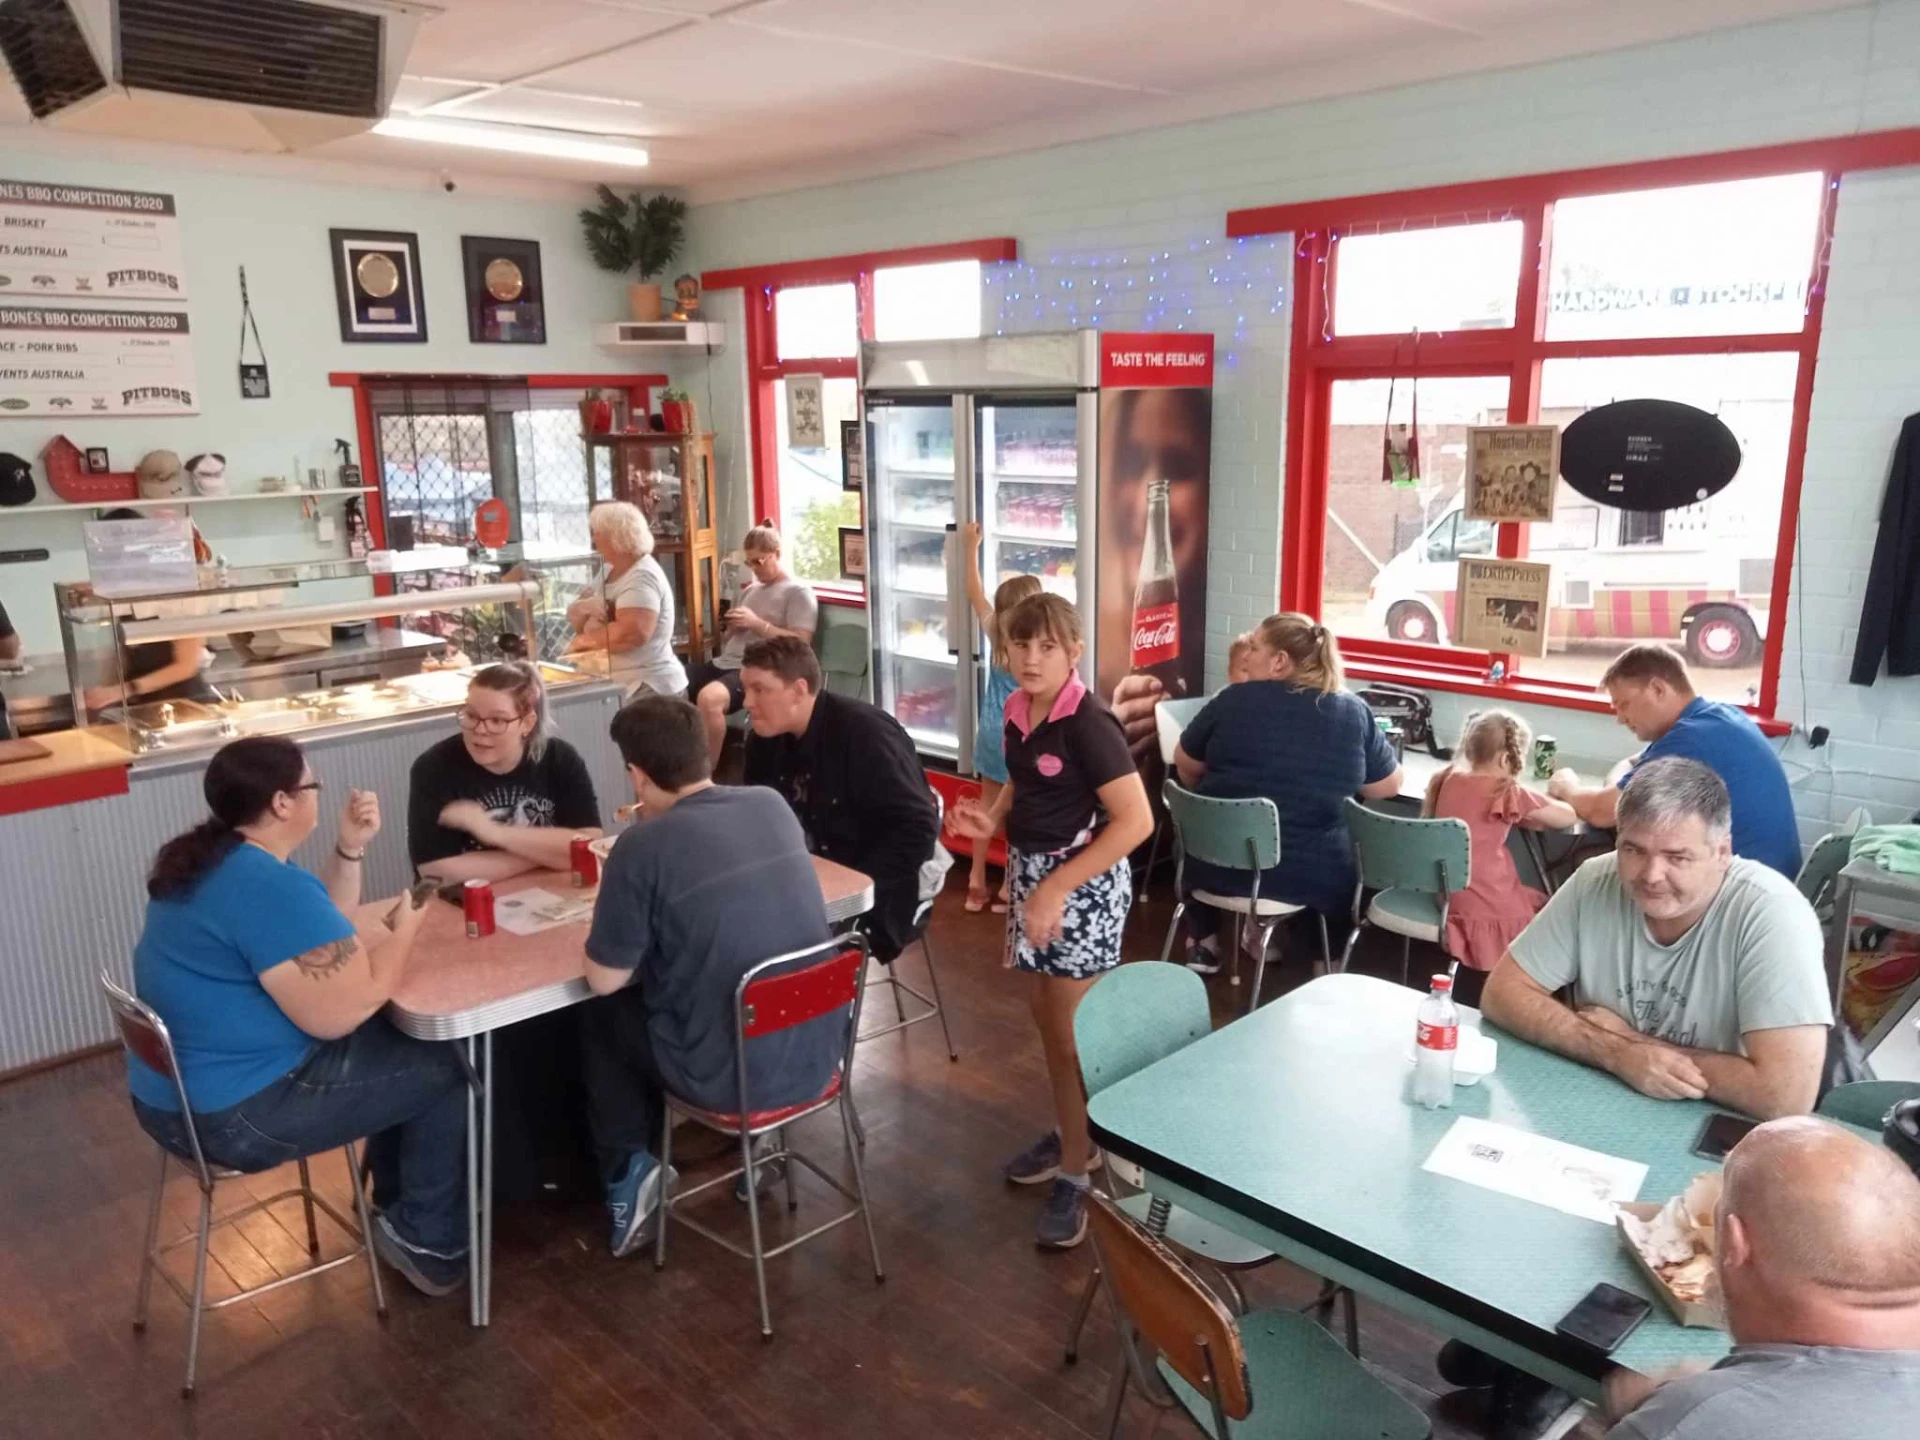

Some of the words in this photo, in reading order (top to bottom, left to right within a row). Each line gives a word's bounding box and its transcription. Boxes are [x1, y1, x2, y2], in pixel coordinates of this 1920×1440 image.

[26, 186, 52, 202] BBQ
[53, 188, 132, 208] COMPETITION
[133, 195, 164, 210] 2020
[4, 217, 46, 229] BRISKET
[13, 245, 68, 258] AUSTRALIA
[106, 269, 179, 291] PITBOSS
[1, 310, 42, 325] BONES
[45, 312, 69, 326] BBQ
[71, 313, 147, 327] COMPETITION
[149, 315, 178, 329] 2020
[27, 342, 54, 352] PORK
[56, 343, 78, 353] RIBS
[1110, 352, 1143, 367] TASTE
[1144, 352, 1165, 367] THE
[1166, 352, 1206, 367] FEELING
[31, 369, 84, 380] AUSTRALIA
[121, 386, 192, 406] PITBOSS
